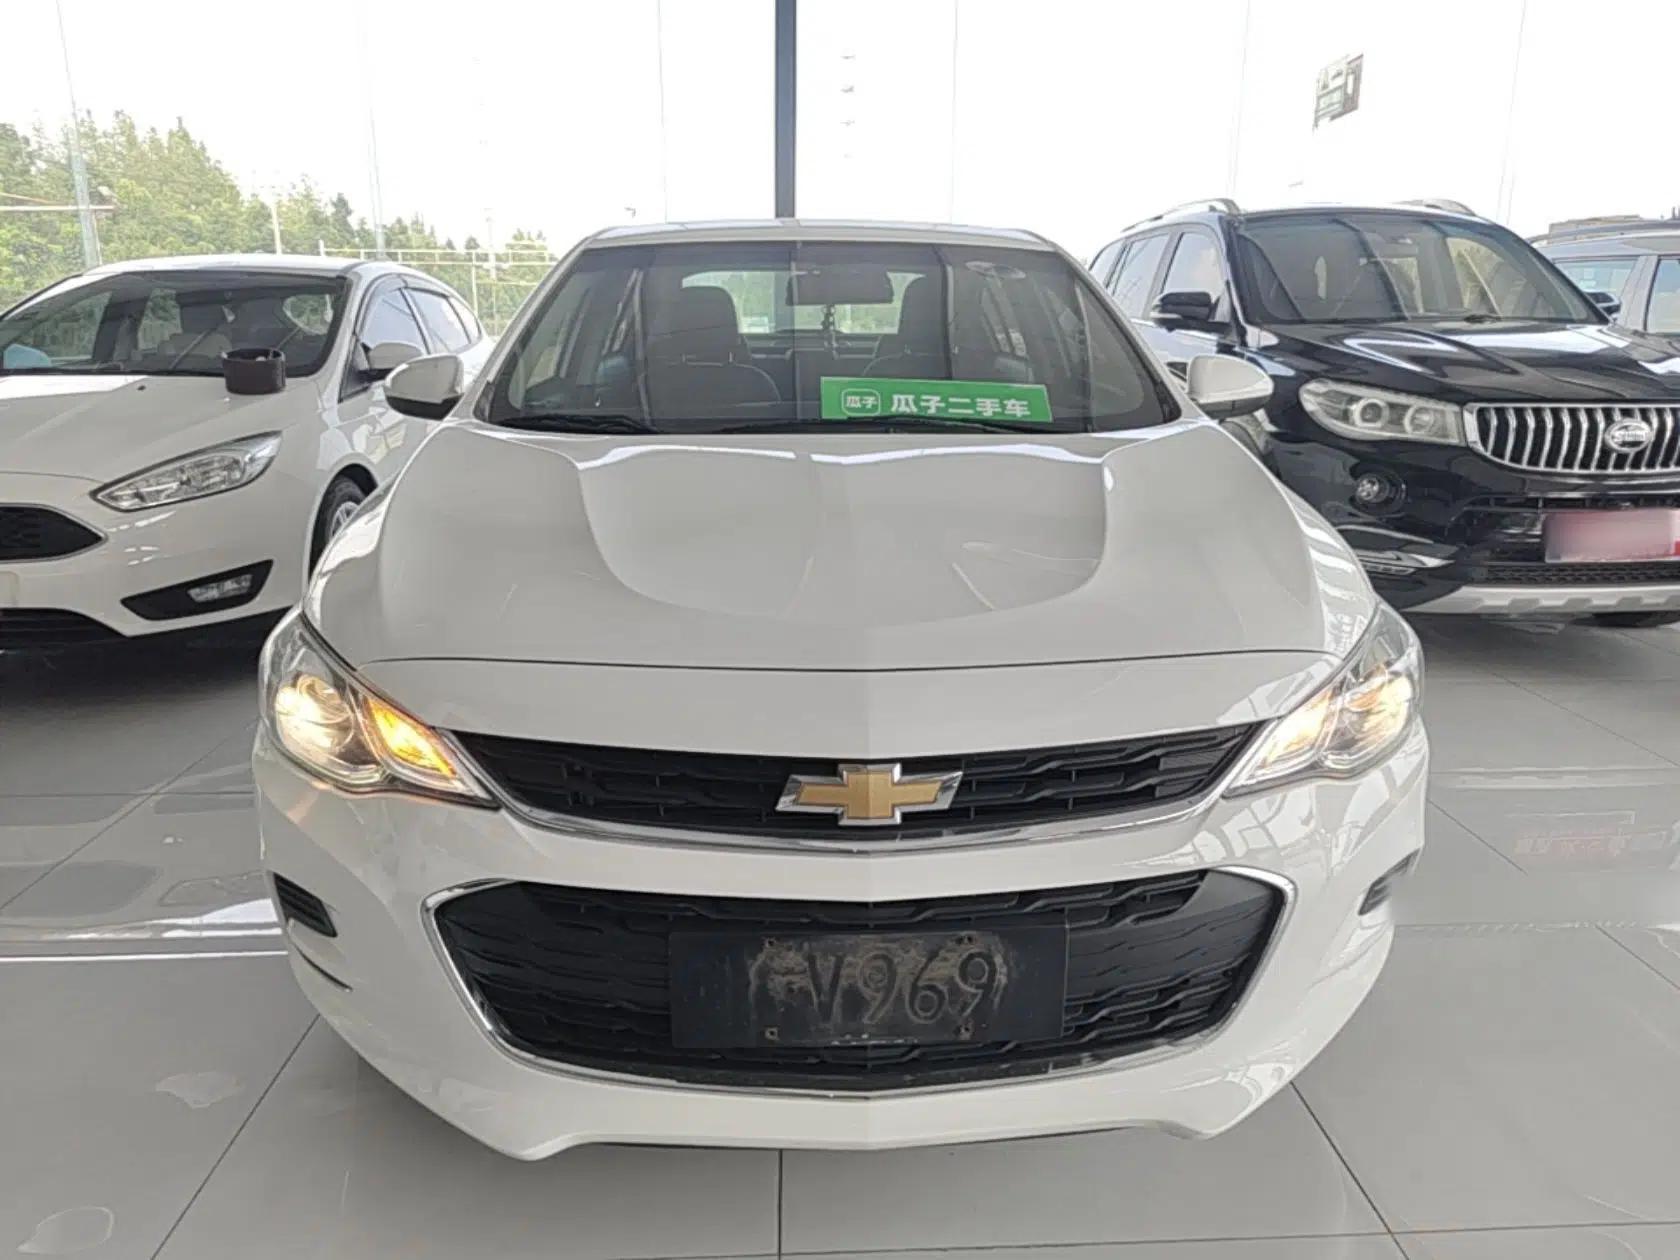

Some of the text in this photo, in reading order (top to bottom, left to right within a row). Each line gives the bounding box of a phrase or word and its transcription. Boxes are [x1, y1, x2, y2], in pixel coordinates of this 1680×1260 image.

[846, 394, 1031, 417] 瓜子 瓜子二手车
